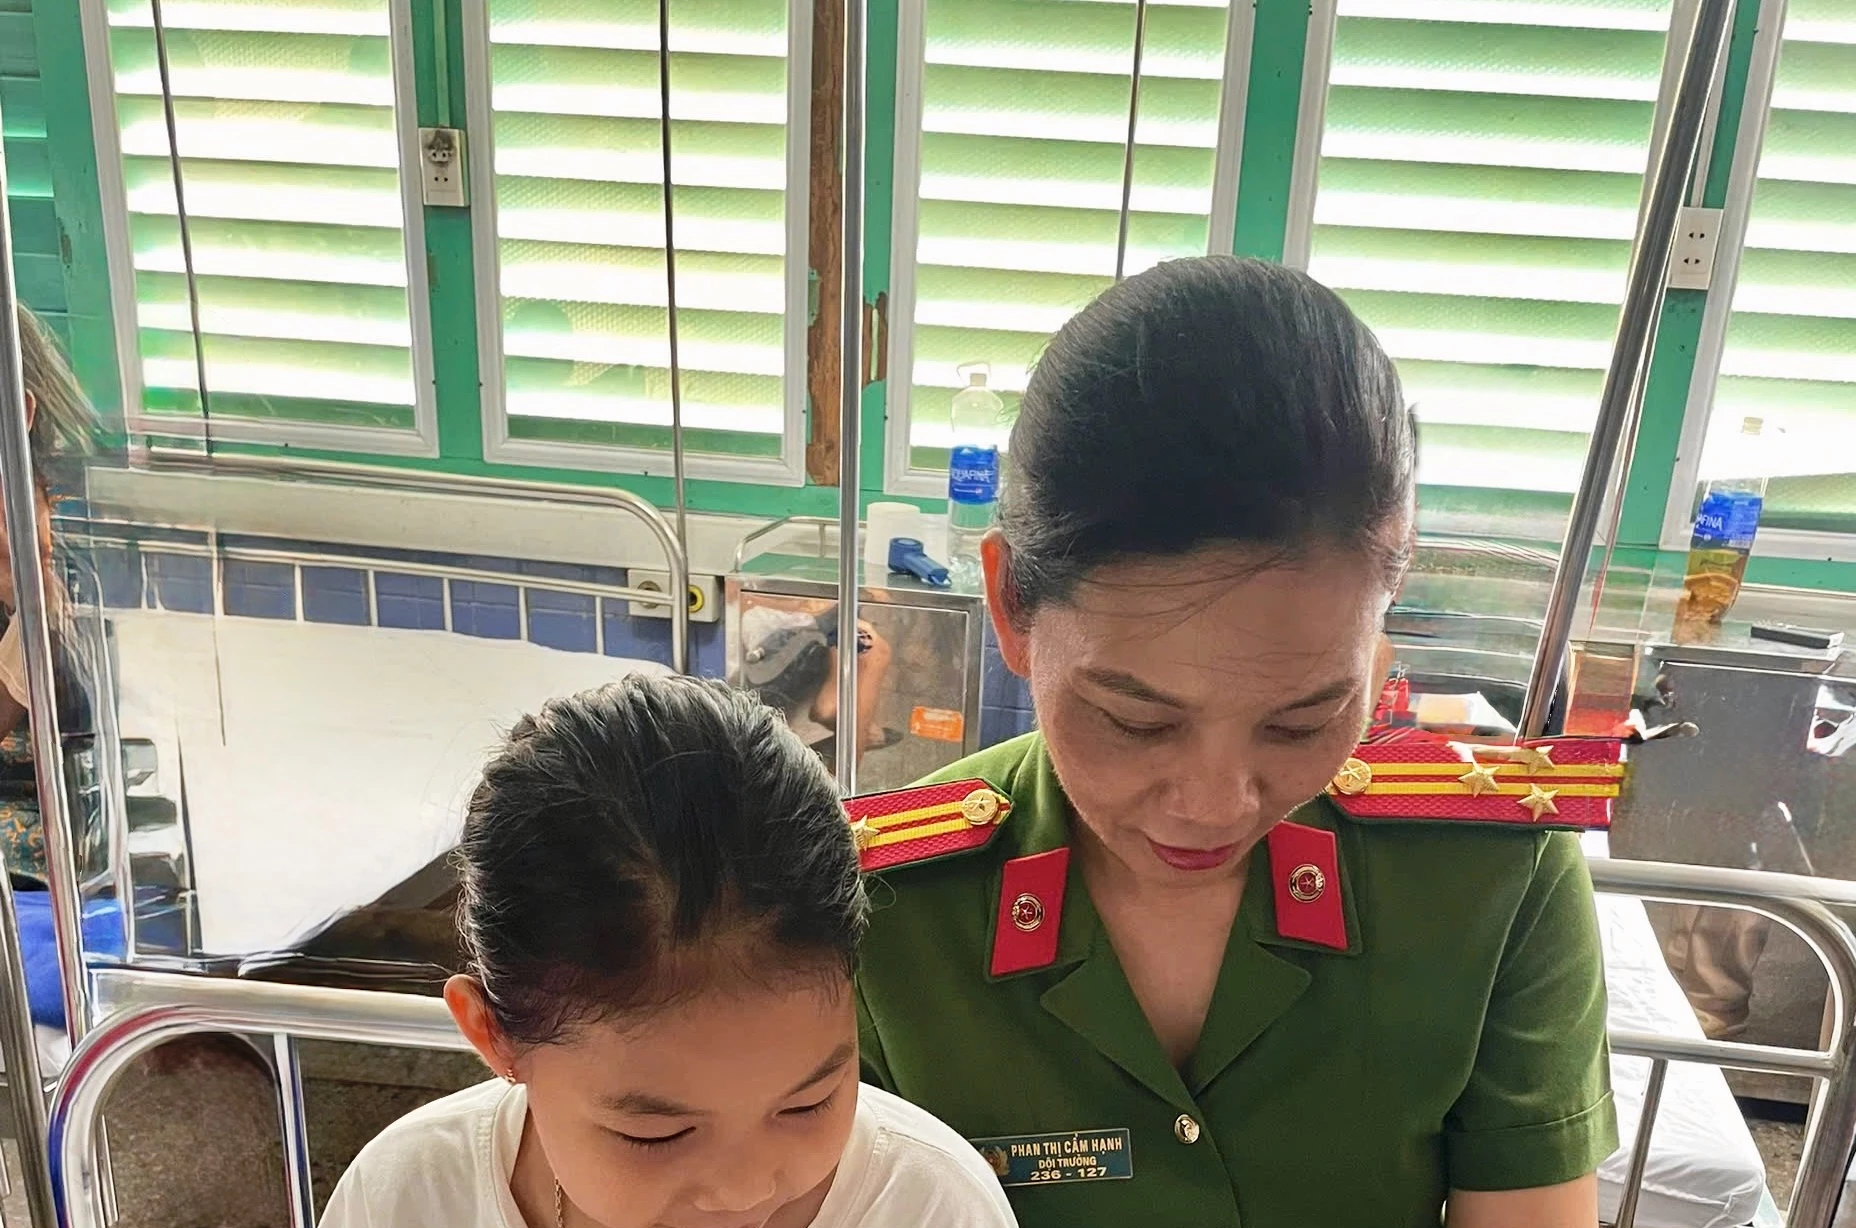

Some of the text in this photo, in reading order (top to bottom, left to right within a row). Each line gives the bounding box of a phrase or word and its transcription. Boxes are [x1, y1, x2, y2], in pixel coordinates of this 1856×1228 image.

[1011, 1143, 1040, 1157] PHAN
[1043, 1141, 1061, 1157] THỊ
[1091, 1137, 1122, 1155] HẠNH
[1030, 1170, 1061, 1180] 236
[1077, 1167, 1107, 1178] 127
